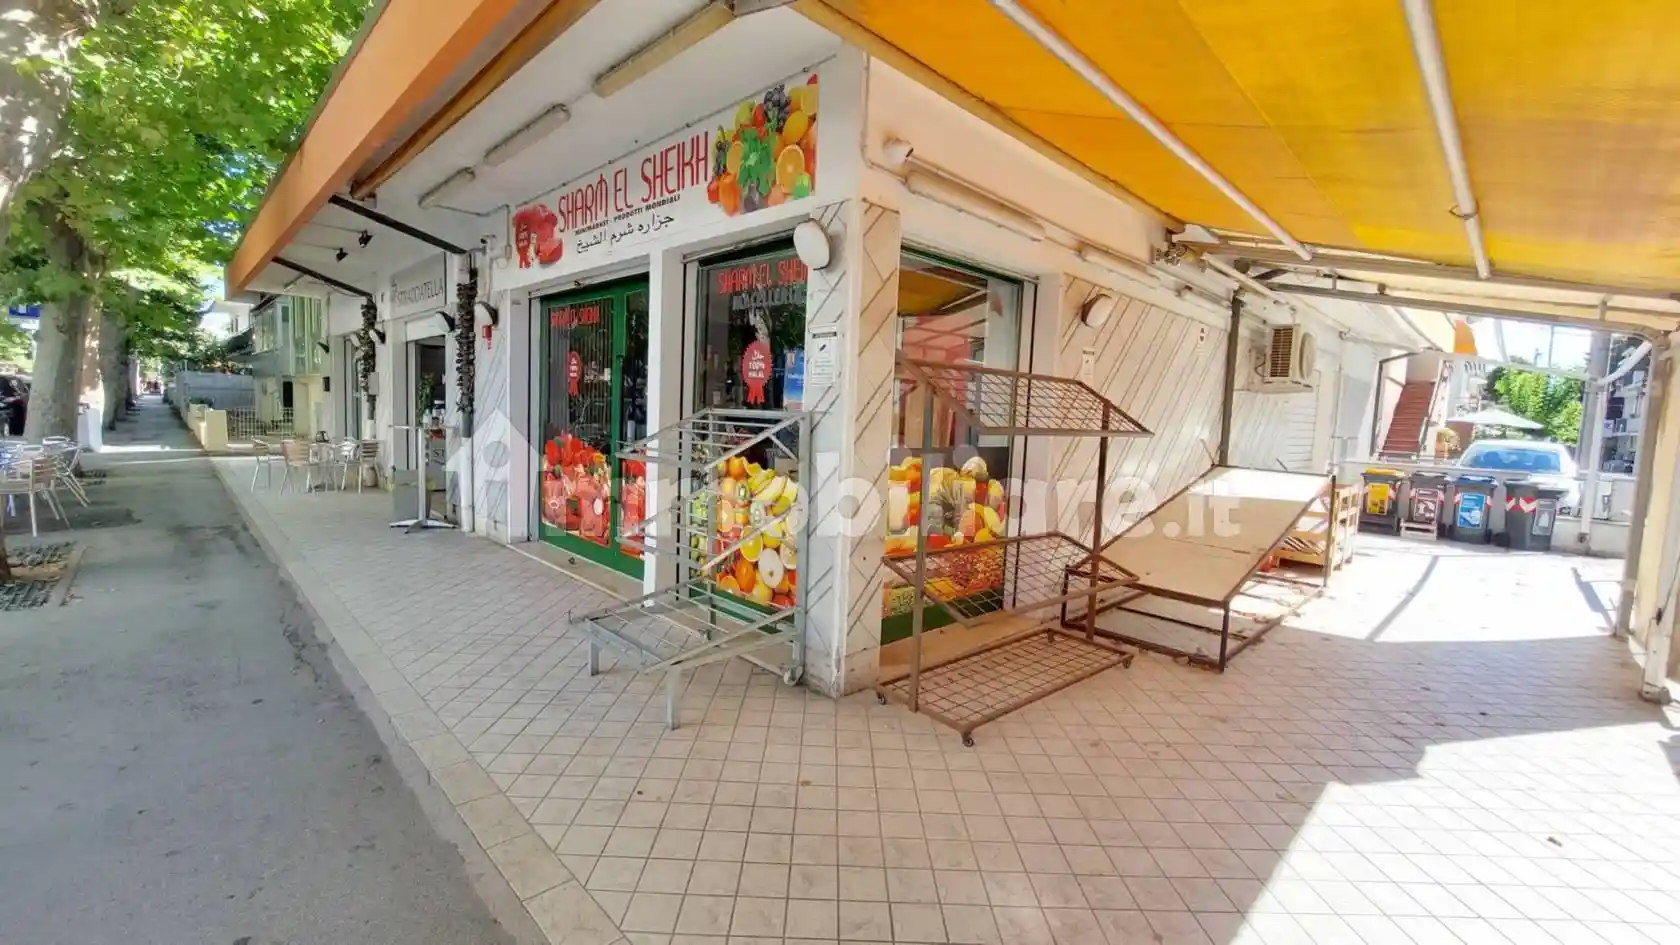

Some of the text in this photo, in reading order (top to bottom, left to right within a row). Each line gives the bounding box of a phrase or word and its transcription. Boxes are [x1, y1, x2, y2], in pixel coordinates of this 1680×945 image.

[558, 131, 709, 232] SHARM EL SHEIKH
[575, 194, 681, 236] MINIMARKET PRODOTTI MONDIALI
[576, 228, 607, 253] الشيخ
[610, 222, 634, 246] شرم
